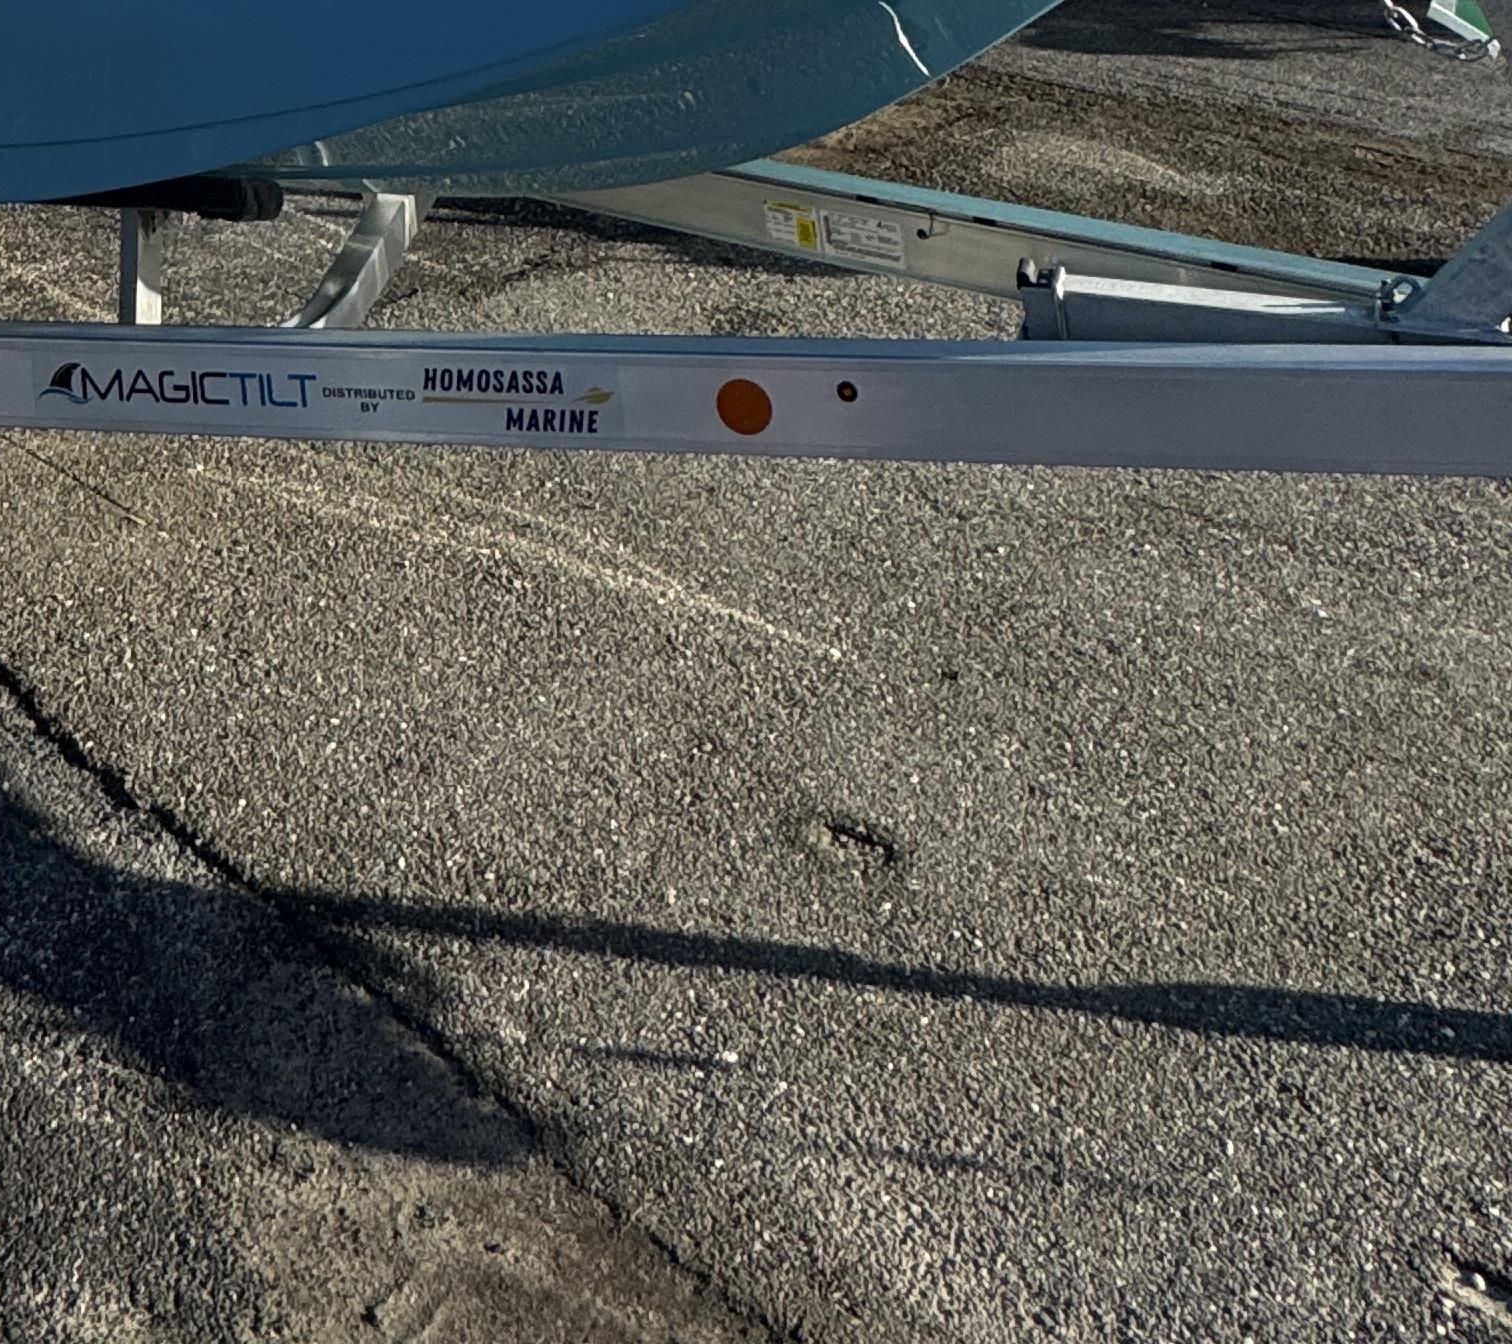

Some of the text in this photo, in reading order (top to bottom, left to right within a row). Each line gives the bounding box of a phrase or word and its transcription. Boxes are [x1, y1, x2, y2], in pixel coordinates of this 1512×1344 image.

[82, 367, 317, 408] MAGICTILT
[322, 387, 416, 402] DISTRIBUTED
[423, 367, 565, 395] HOMOSASSA
[360, 402, 380, 413] BY
[505, 407, 600, 434] MARINE
